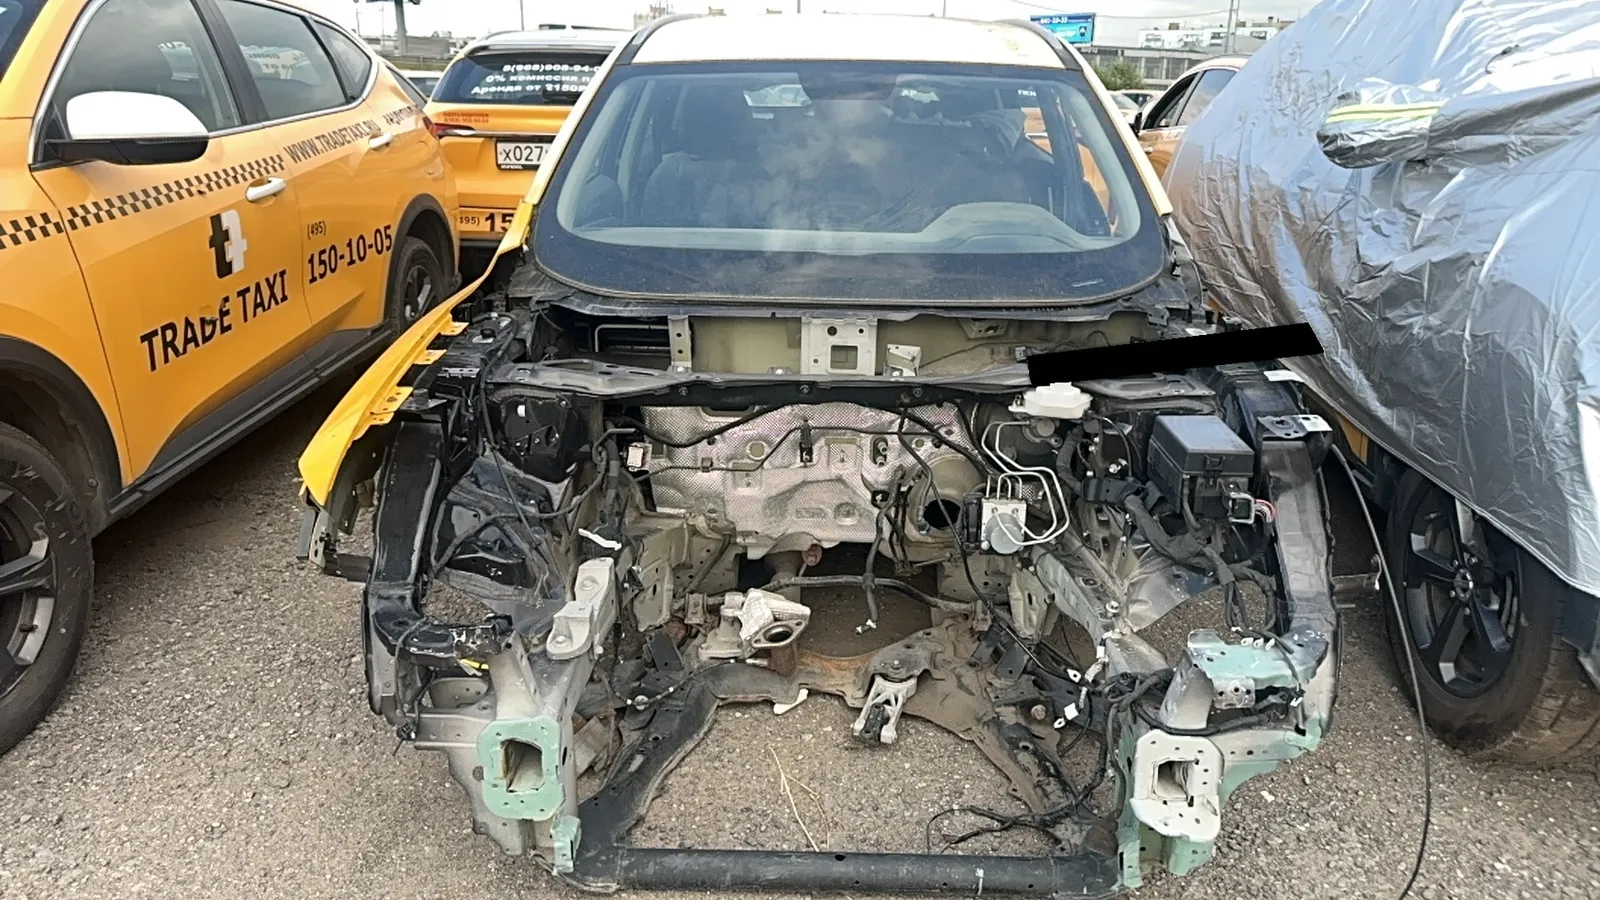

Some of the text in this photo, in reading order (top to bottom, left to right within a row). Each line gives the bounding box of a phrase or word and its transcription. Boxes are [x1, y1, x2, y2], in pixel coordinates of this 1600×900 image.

[471, 84, 522, 94] Аренда
[525, 84, 542, 92] от
[485, 74, 506, 83] 0%
[307, 219, 327, 241] (495)
[307, 224, 393, 285] 150-10-05
[139, 268, 289, 373] TRADE TAXI
